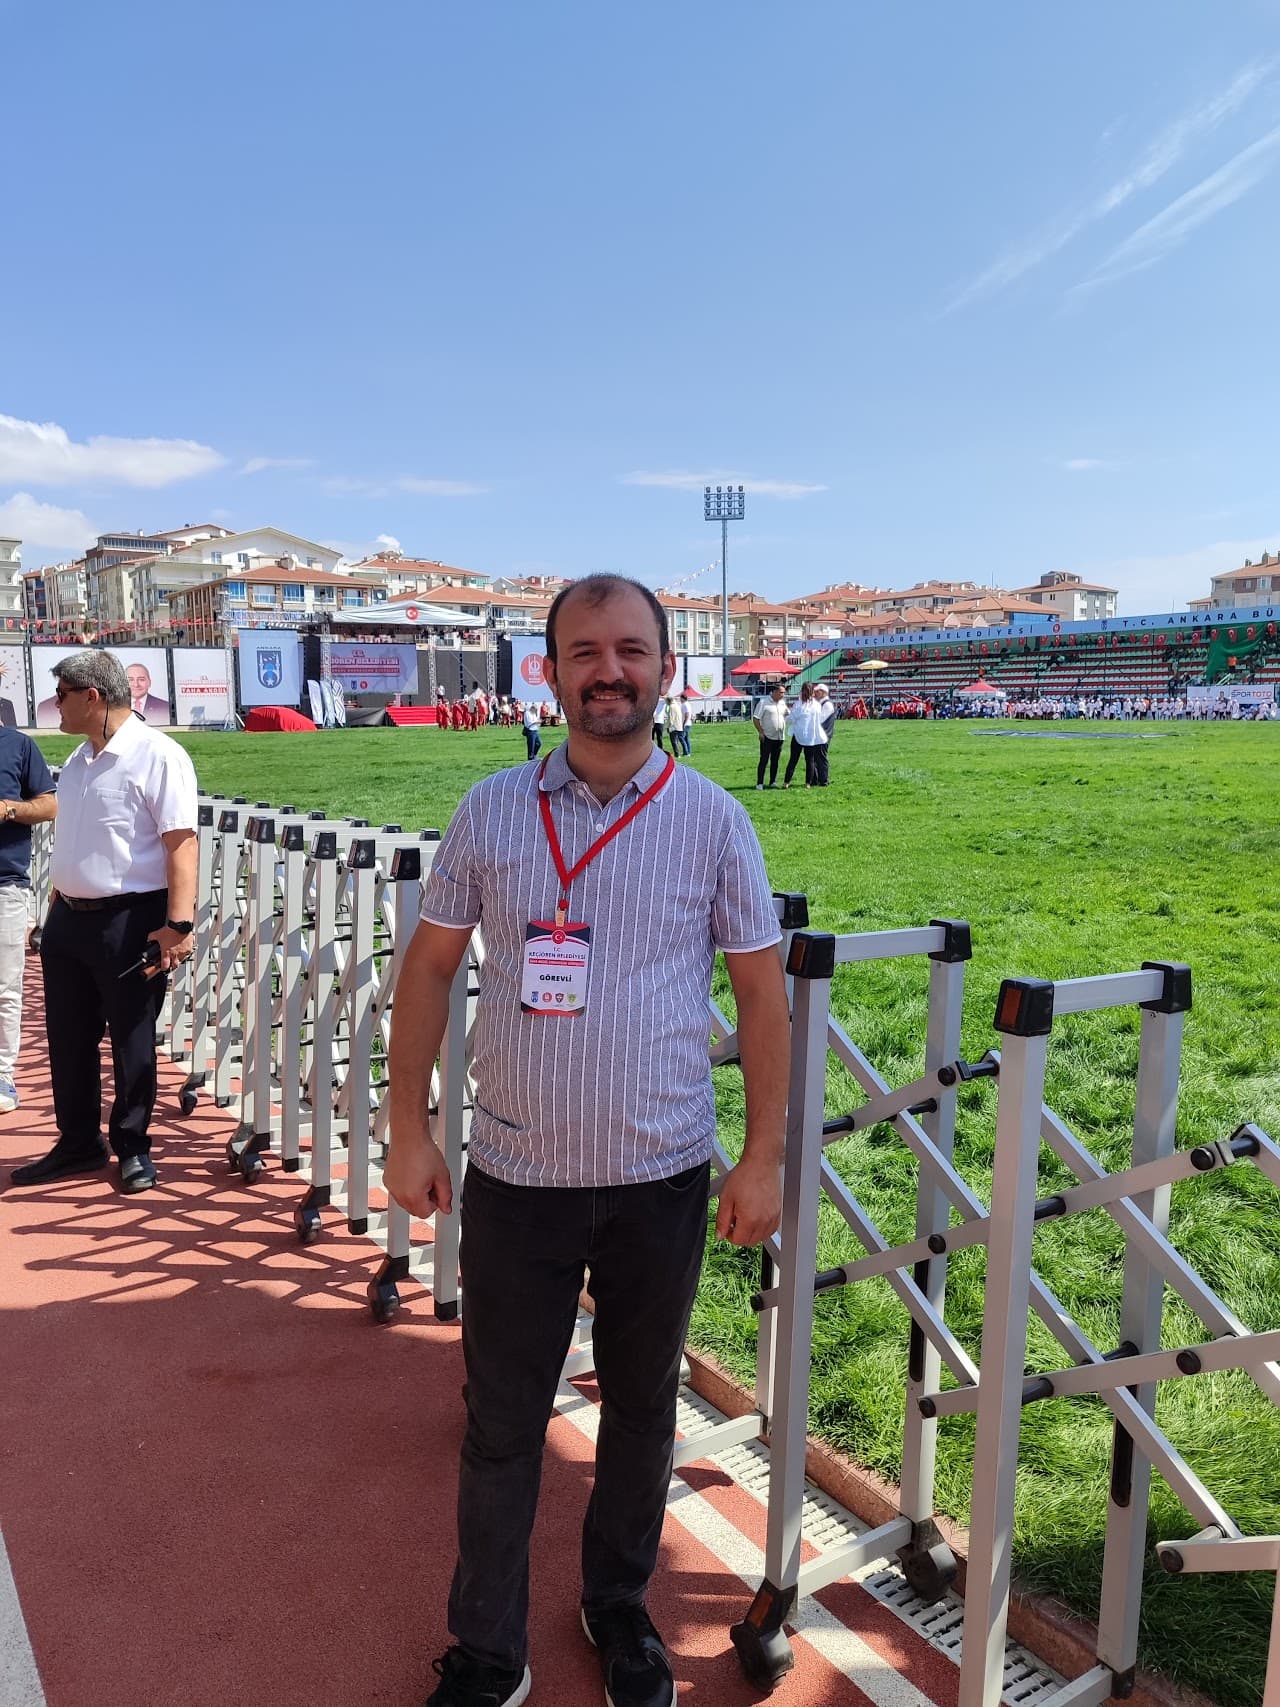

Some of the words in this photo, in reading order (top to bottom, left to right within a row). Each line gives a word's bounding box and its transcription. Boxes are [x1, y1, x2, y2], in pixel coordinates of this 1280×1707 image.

[1122, 618, 1155, 629] T.C.
[1167, 611, 1238, 626] ANKARA
[1252, 607, 1275, 619] BÜ
[855, 635, 924, 647] KEÇİÖREN
[936, 624, 1033, 640] BELEDİYESİ
[539, 974, 572, 982] GÖREVLİ
